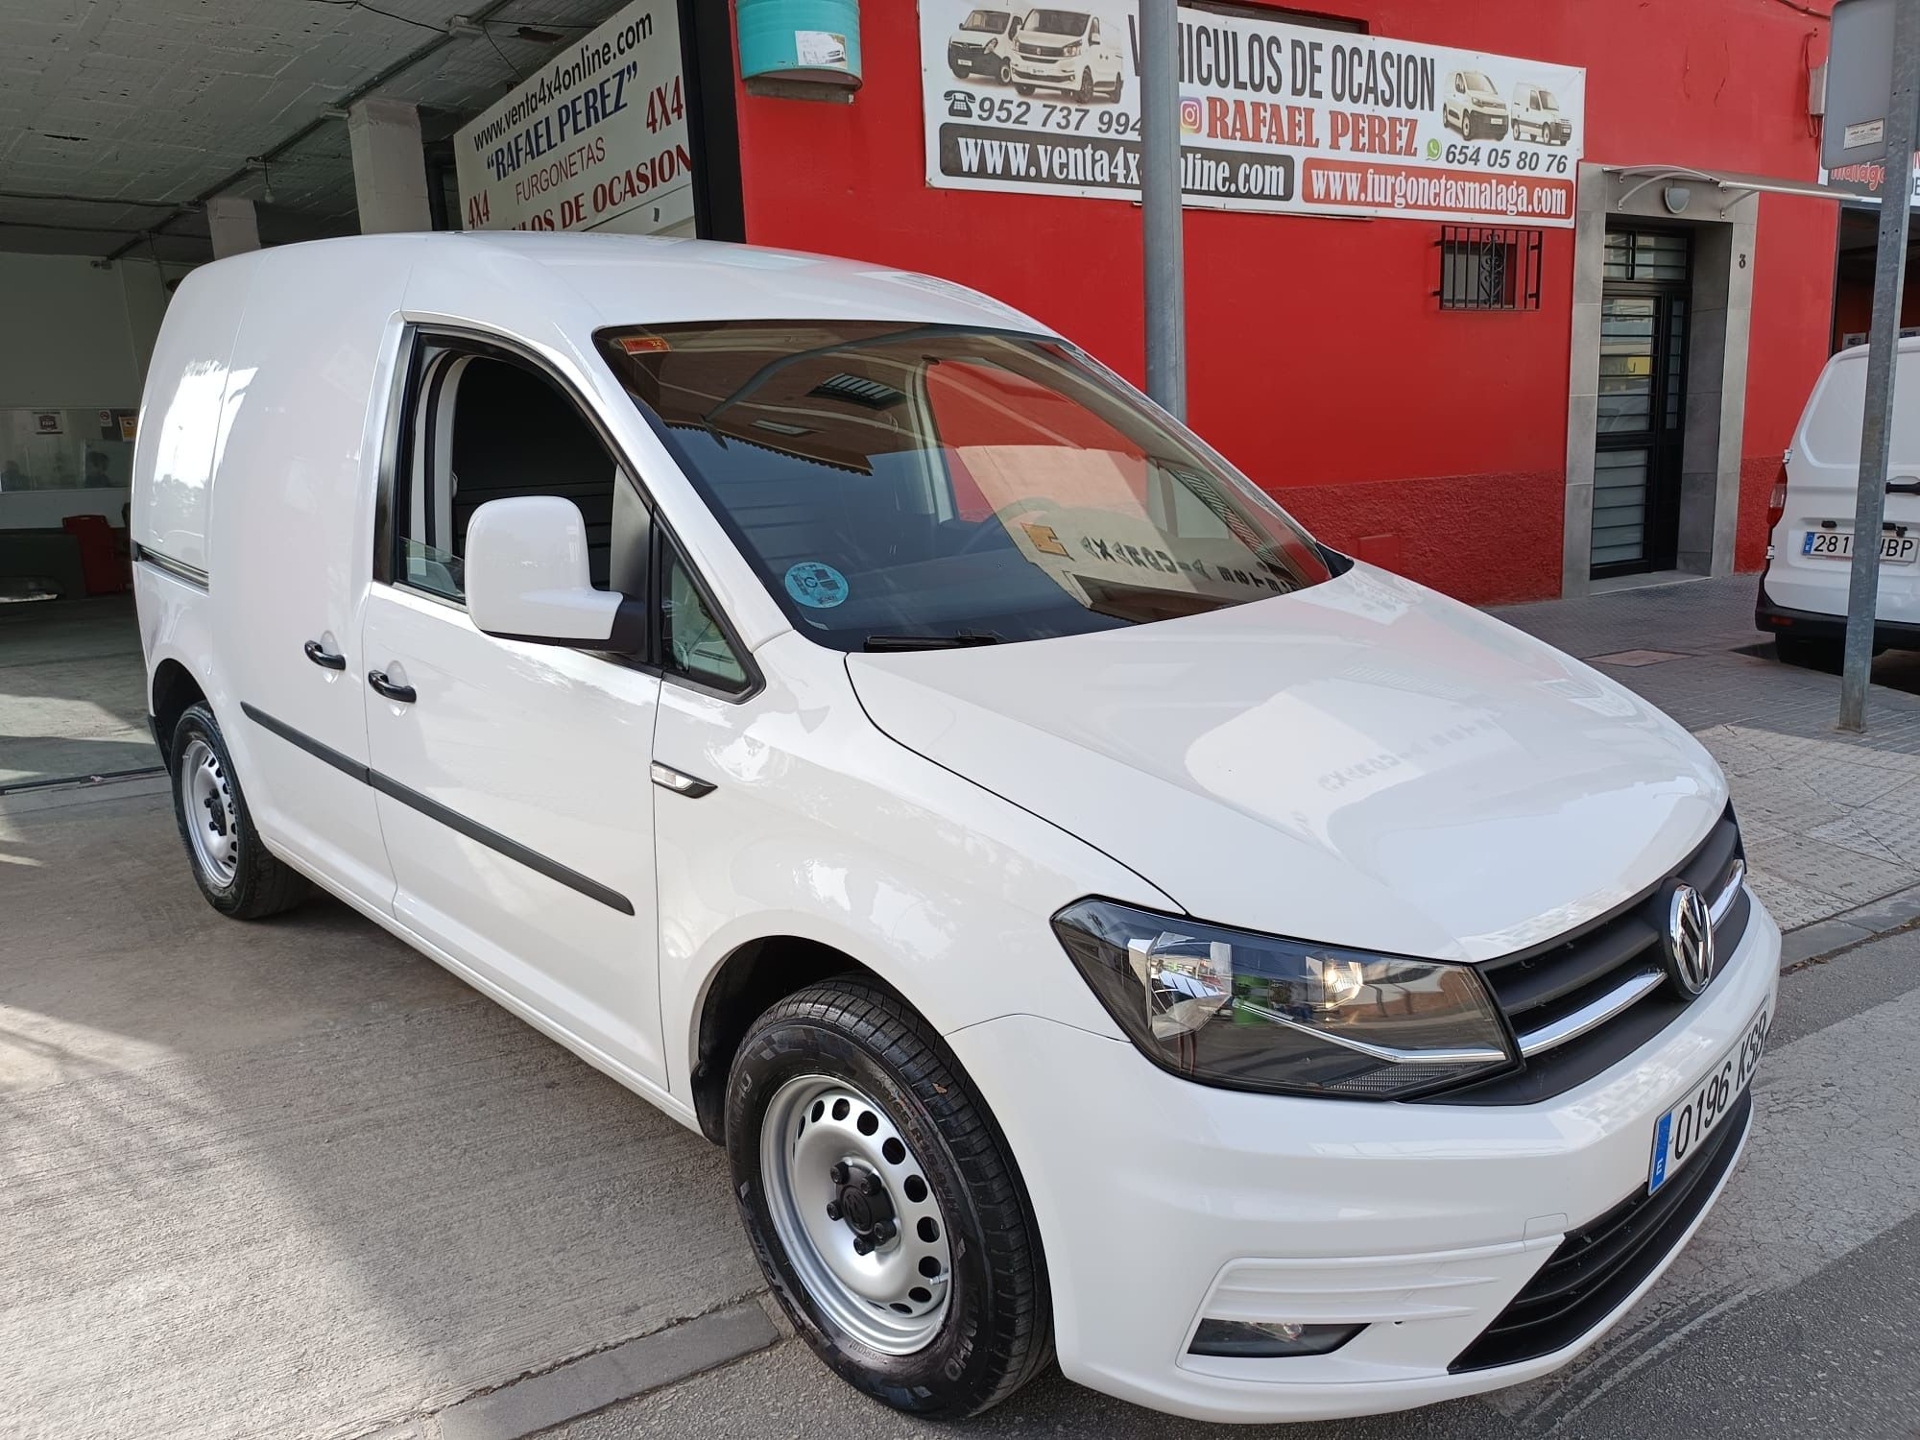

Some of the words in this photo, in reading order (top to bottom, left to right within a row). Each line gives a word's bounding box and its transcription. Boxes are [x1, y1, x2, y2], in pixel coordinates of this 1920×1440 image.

[473, 12, 653, 153] www.venta4x4online.com
[645, 75, 684, 135] 4X4
[1291, 38, 1323, 100] DE
[1331, 44, 1435, 112] OCASION
[977, 96, 1031, 126] 952
[1040, 103, 1089, 132] 737
[1206, 96, 1319, 148] RAFAEL
[1329, 110, 1418, 157] PEREZ
[515, 136, 606, 205] FURGONETAS
[560, 192, 587, 230] DE
[592, 143, 692, 214] OCASION
[1445, 143, 1480, 166] 654
[1487, 147, 1511, 169] 05
[1516, 150, 1539, 172] 80
[1546, 153, 1568, 174] 76
[468, 188, 490, 230] 4X4
[1311, 168, 1567, 216] www.furgonetasmalaga.com
[1738, 253, 1747, 270] 3
[1674, 1060, 1732, 1160] 0196
